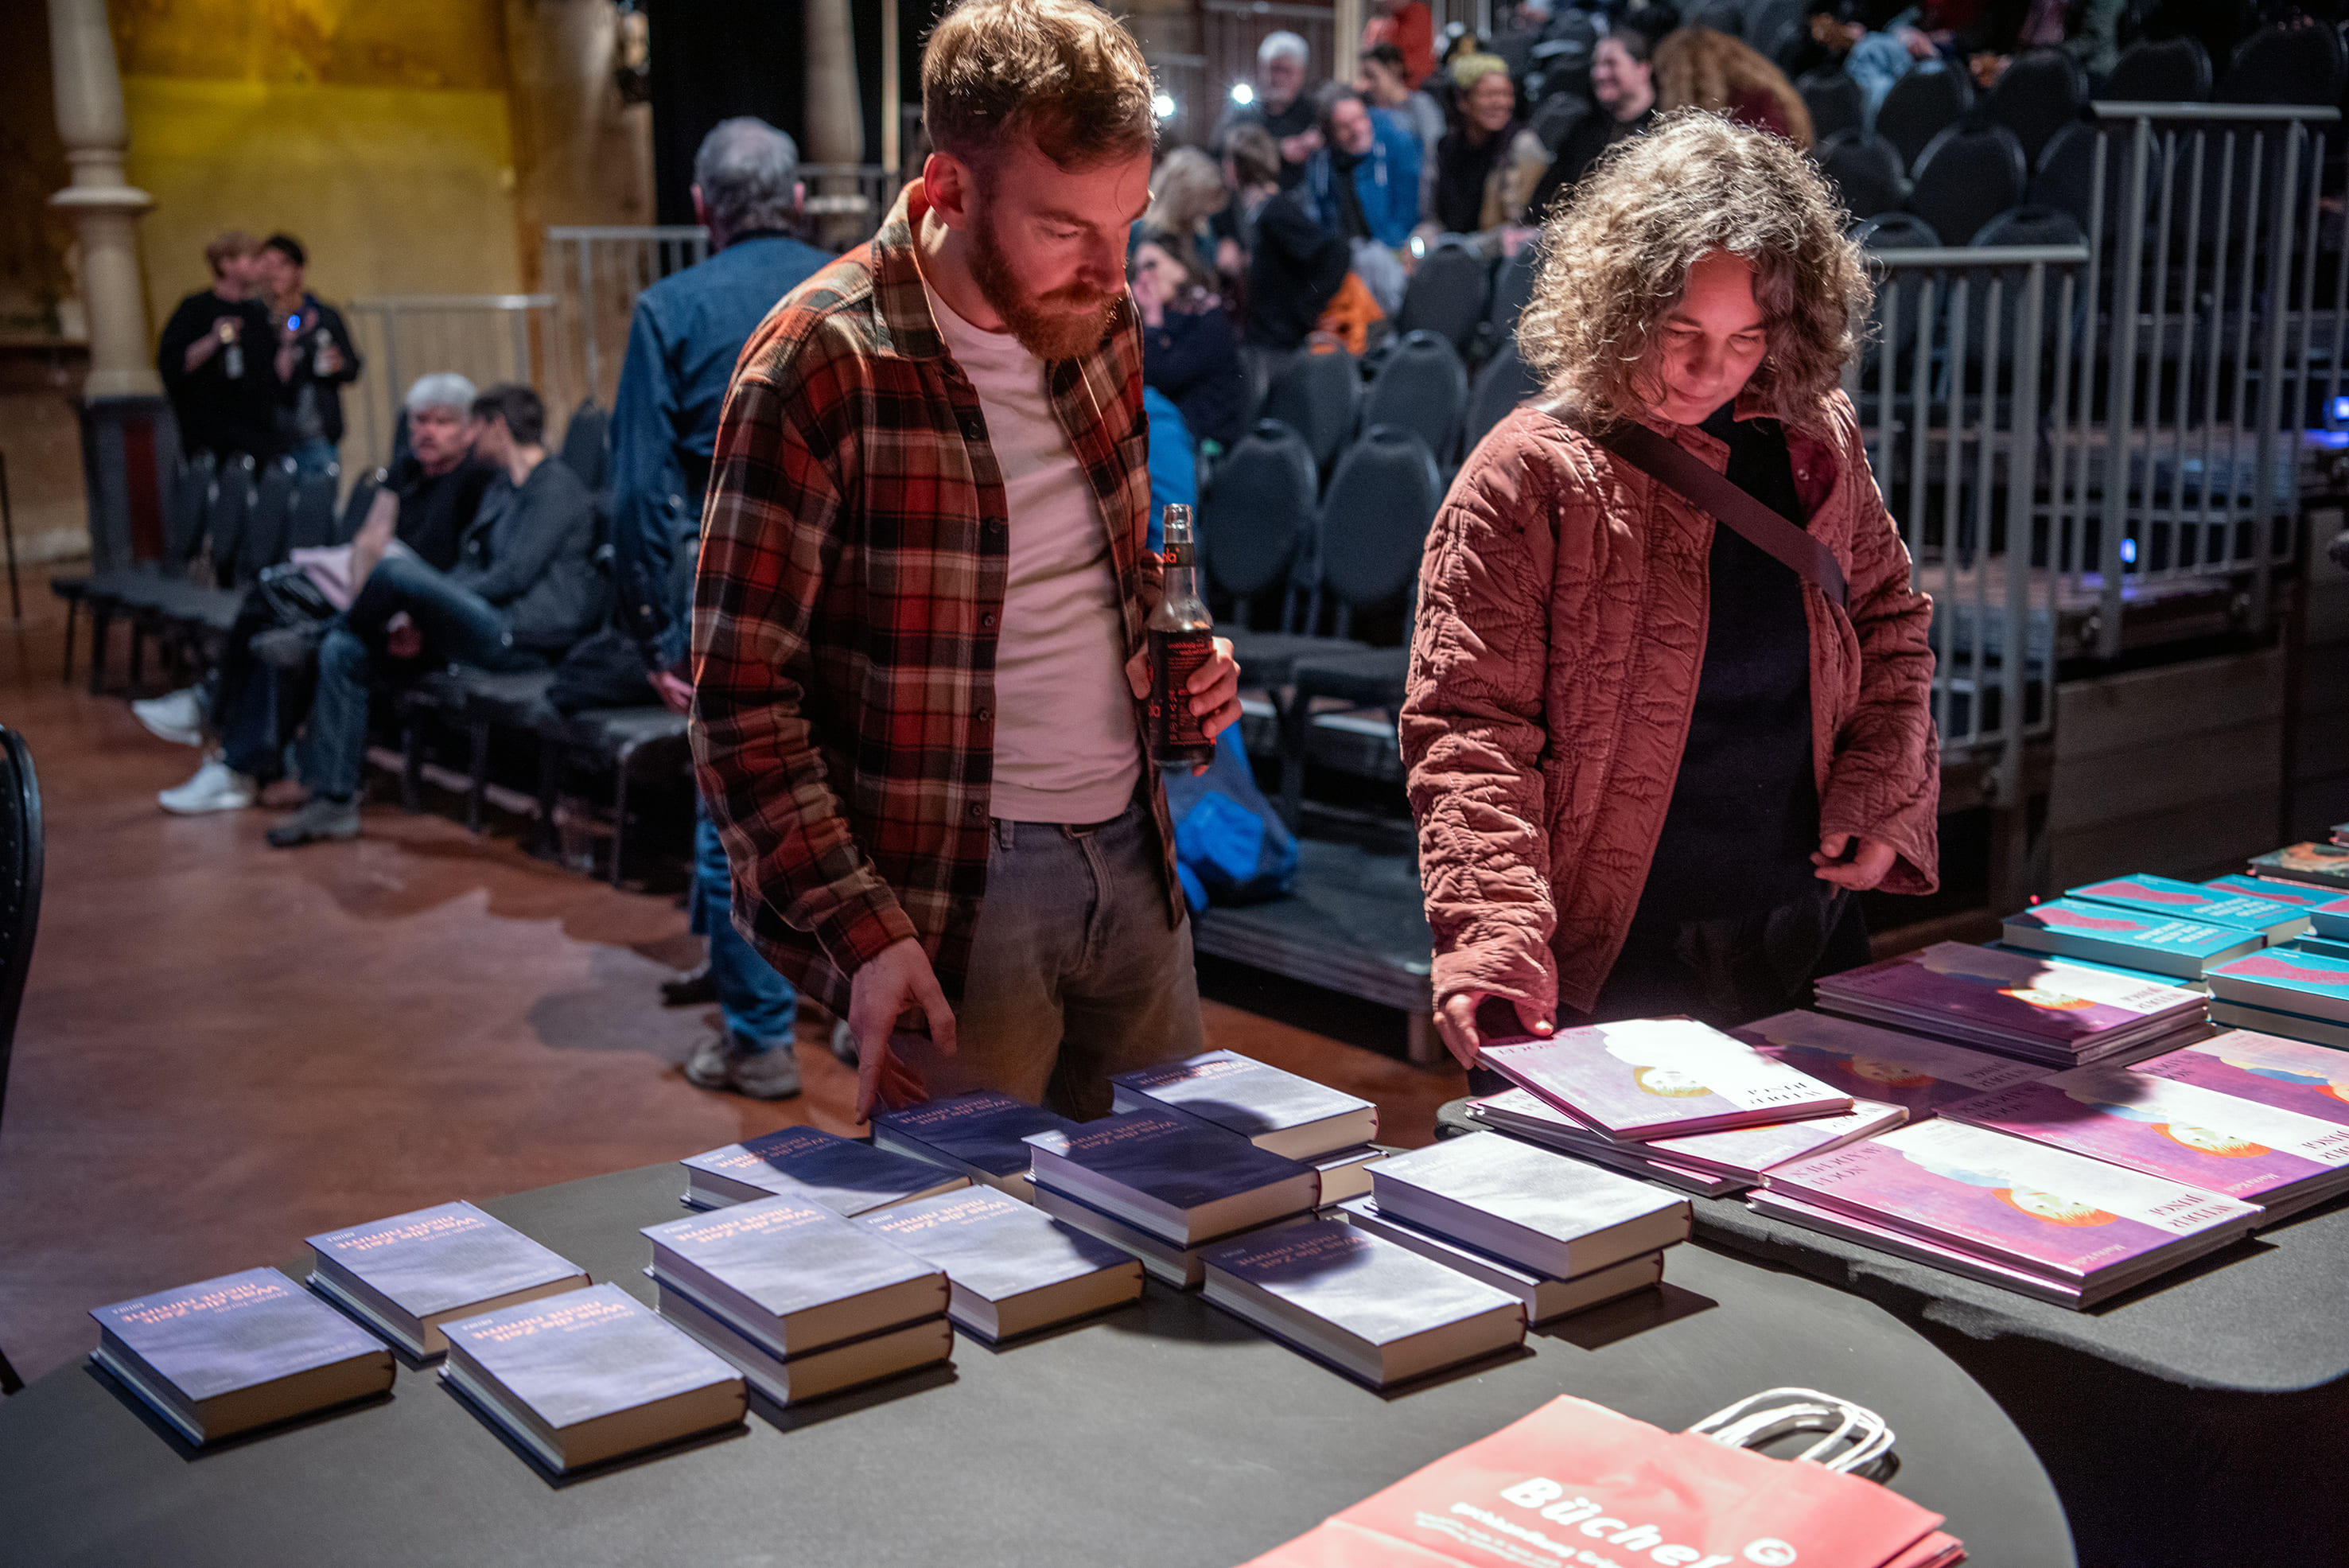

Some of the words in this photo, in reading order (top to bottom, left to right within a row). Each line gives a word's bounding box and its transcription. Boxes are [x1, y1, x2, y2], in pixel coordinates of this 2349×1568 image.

[1810, 1165, 1869, 1186] NOCH
[936, 1199, 990, 1215] nicht
[963, 1200, 1011, 1215] Was
[2144, 1194, 2205, 1216] JUNGE
[403, 1215, 457, 1231] nicht
[430, 1216, 478, 1231] Was
[739, 1207, 796, 1224] nicht
[767, 1208, 818, 1224] Was
[875, 1211, 943, 1231] nimmt
[933, 1210, 970, 1223] die
[2167, 1204, 2234, 1228] WEDER
[671, 1220, 746, 1241] nimmt
[734, 1219, 773, 1231] die
[896, 1219, 940, 1233] Zeit
[334, 1228, 405, 1250] nimmt
[396, 1228, 431, 1239] die
[692, 1228, 741, 1243] Zeit
[352, 1235, 399, 1251] Zeit
[230, 1284, 282, 1301] Was
[190, 1297, 229, 1311] die
[544, 1300, 605, 1321] nicht
[574, 1302, 628, 1321] Was
[139, 1306, 191, 1325] Zeit
[538, 1315, 577, 1329] die
[469, 1315, 546, 1340] nimmt
[490, 1325, 540, 1343] Zeit
